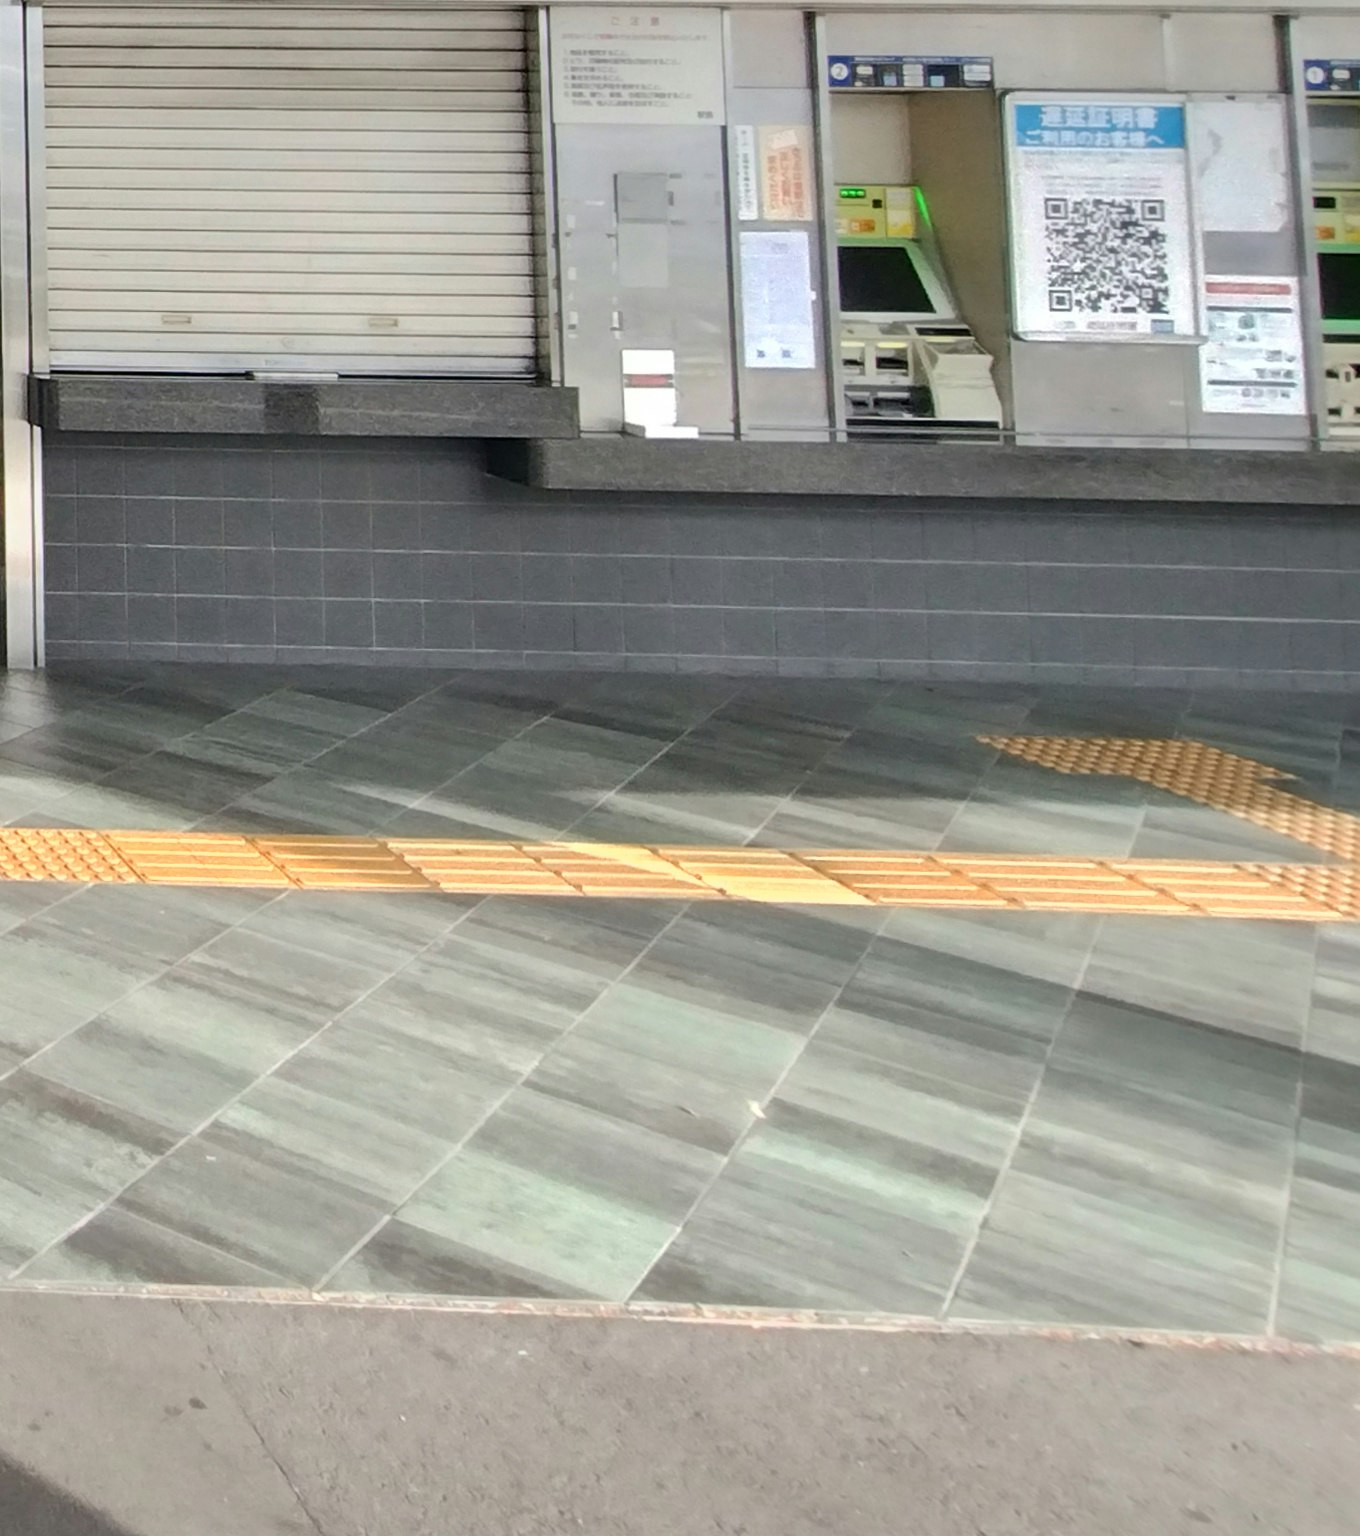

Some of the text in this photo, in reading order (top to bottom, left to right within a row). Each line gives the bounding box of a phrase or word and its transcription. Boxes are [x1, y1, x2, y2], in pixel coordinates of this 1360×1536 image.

[1040, 106, 1158, 129] 遅延証明書
[1025, 129, 1165, 145] ご利用のお客様へ
